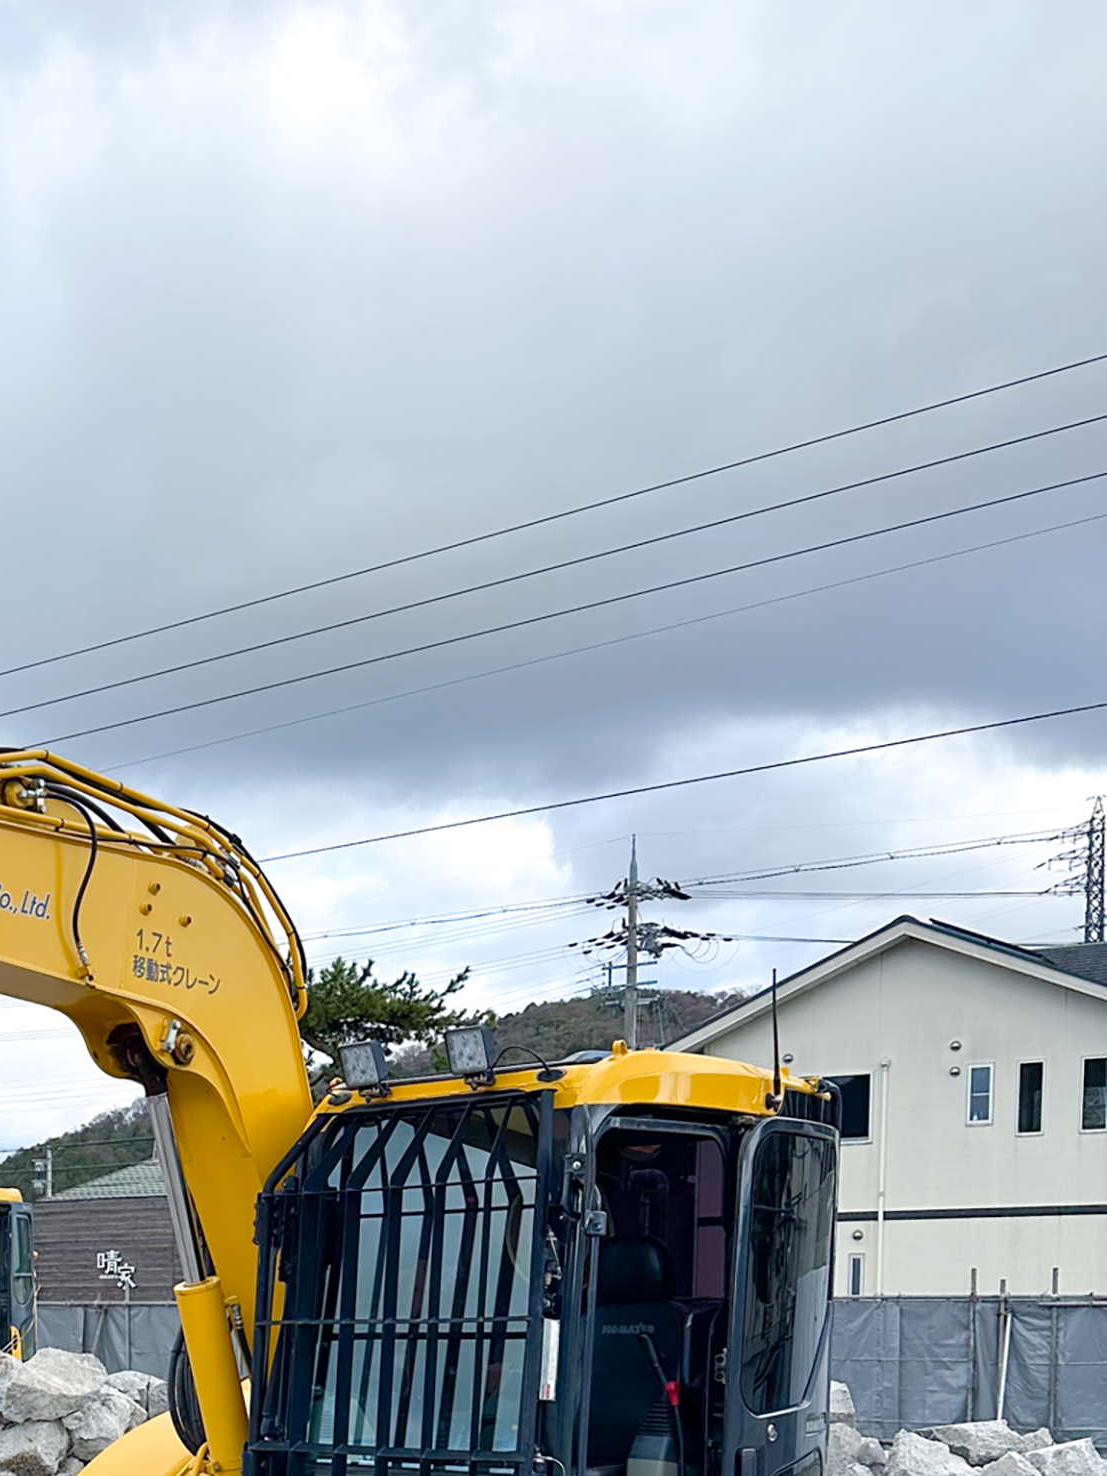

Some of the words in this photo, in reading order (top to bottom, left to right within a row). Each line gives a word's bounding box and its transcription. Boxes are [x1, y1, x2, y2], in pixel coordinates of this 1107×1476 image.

[132, 954, 221, 994] 移動式クレーン
